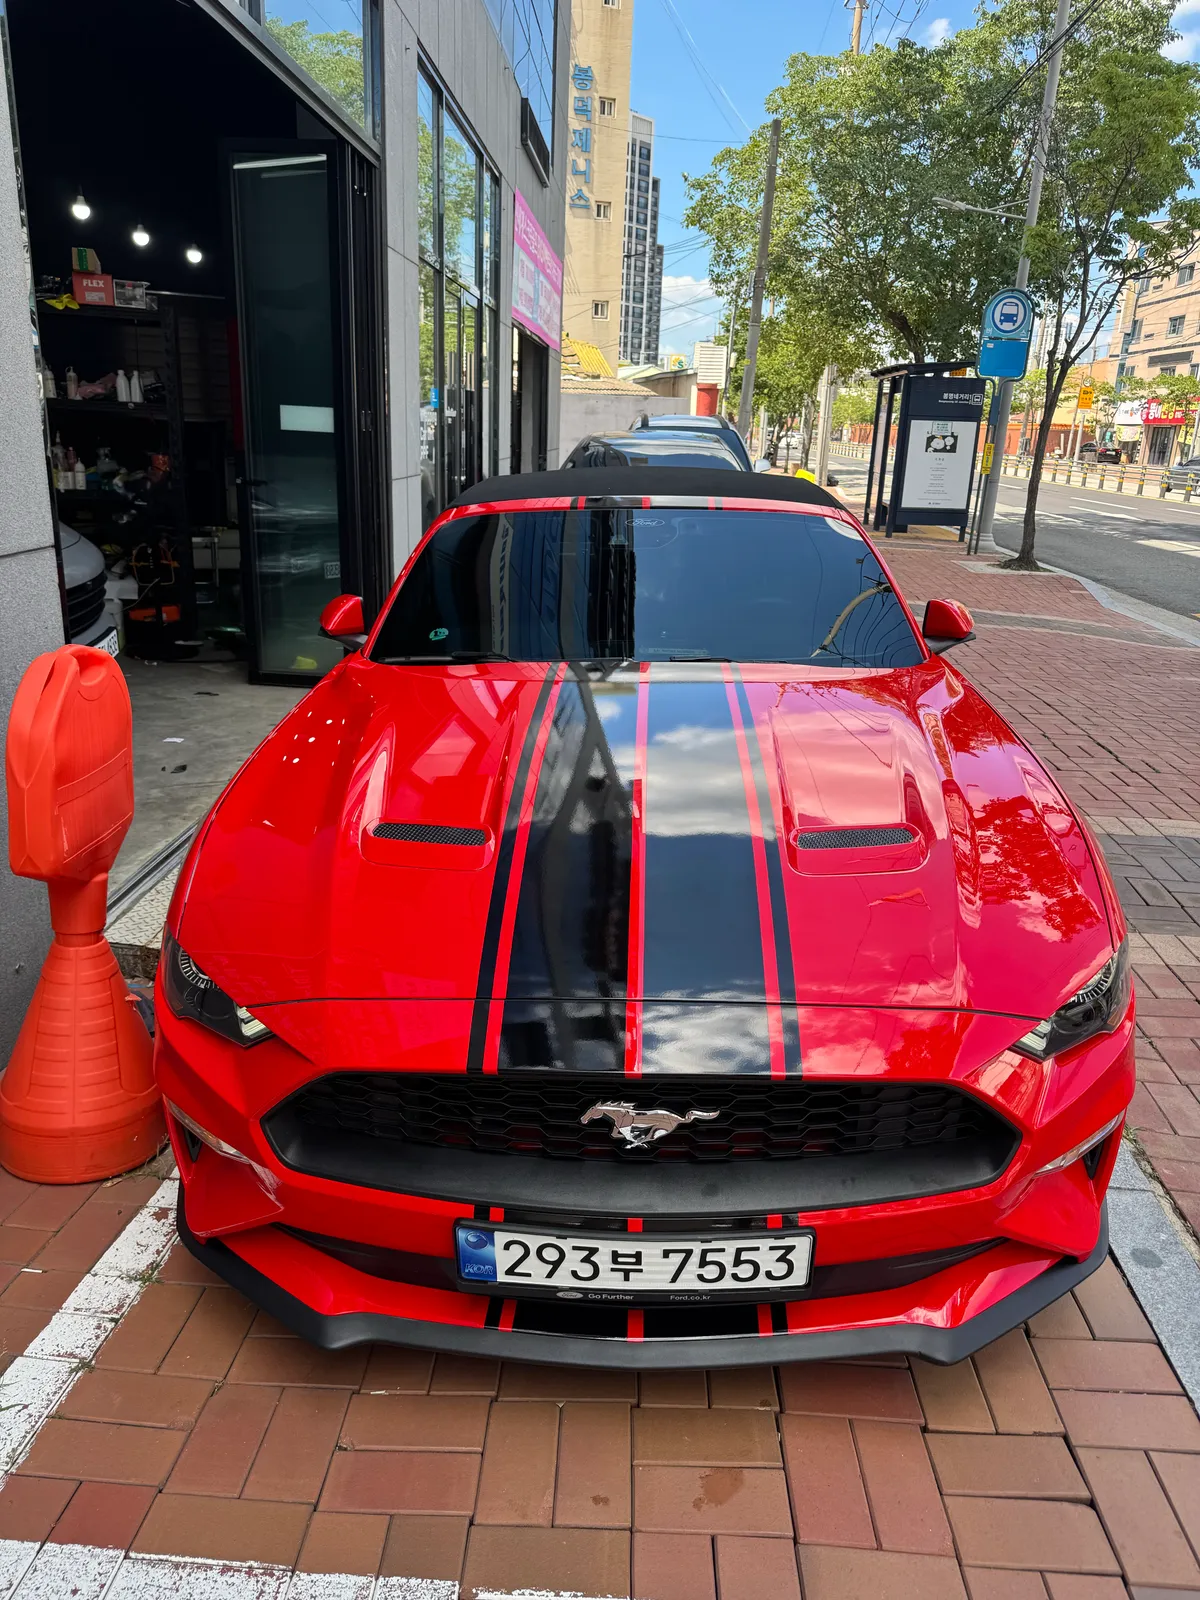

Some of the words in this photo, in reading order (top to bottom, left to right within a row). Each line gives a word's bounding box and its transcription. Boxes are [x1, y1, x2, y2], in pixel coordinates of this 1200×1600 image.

[569, 64, 594, 209] 봉덕제니스
[82, 278, 105, 287] FLEX
[464, 1263, 493, 1275] KOR
[503, 1240, 644, 1283] 293부
[661, 1244, 797, 1284] 7553
